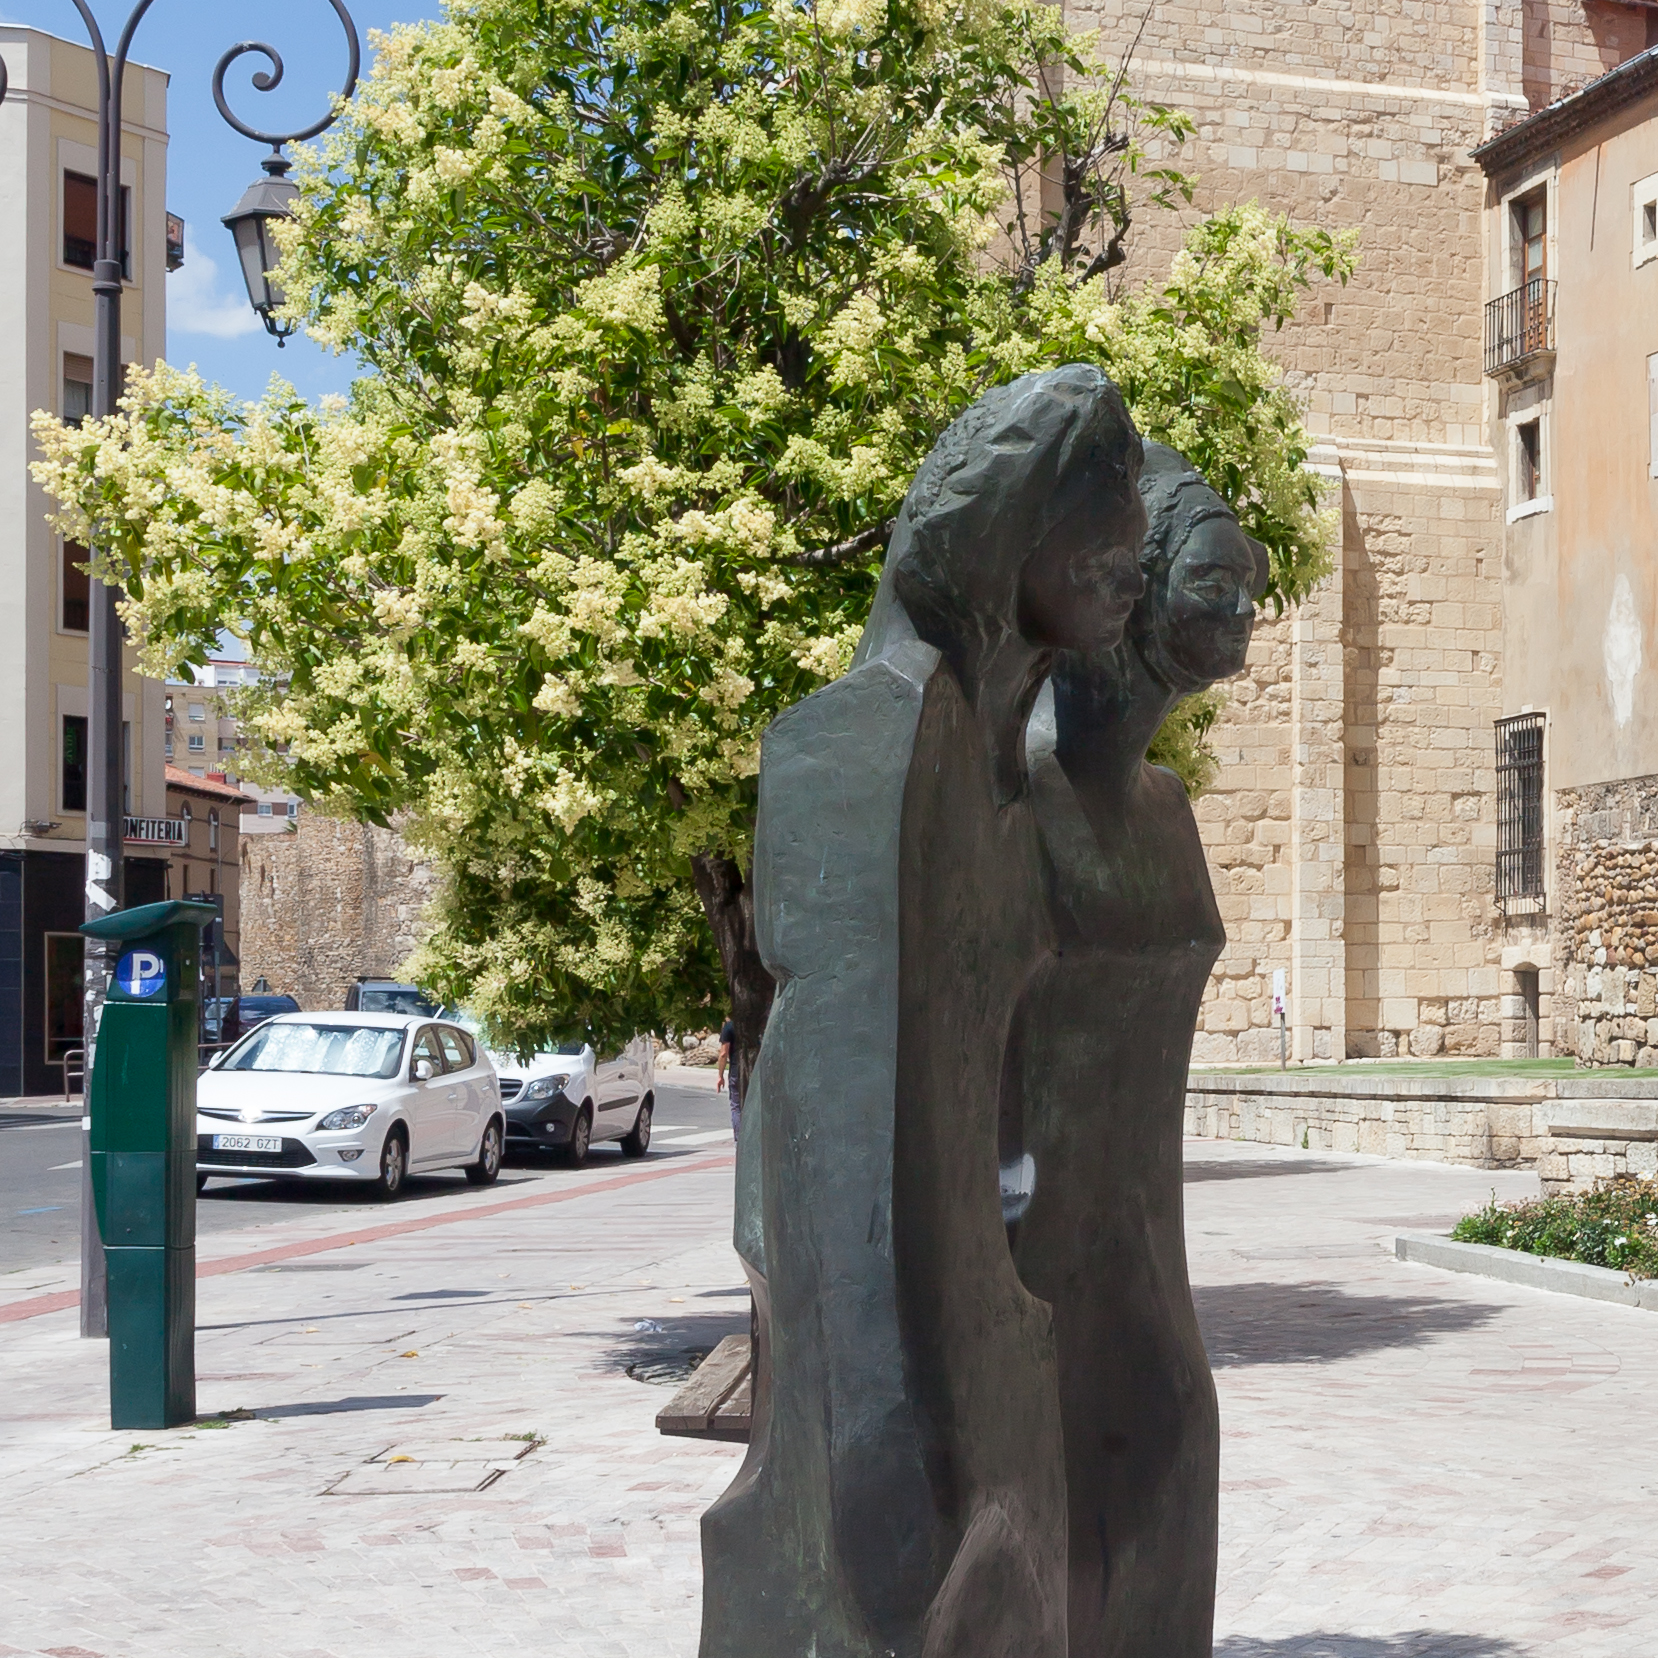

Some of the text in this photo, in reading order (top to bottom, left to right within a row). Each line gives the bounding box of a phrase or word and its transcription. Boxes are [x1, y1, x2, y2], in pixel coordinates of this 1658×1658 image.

[123, 817, 184, 840] ONFITERIA
[222, 1136, 279, 1150] 2062 GZT
